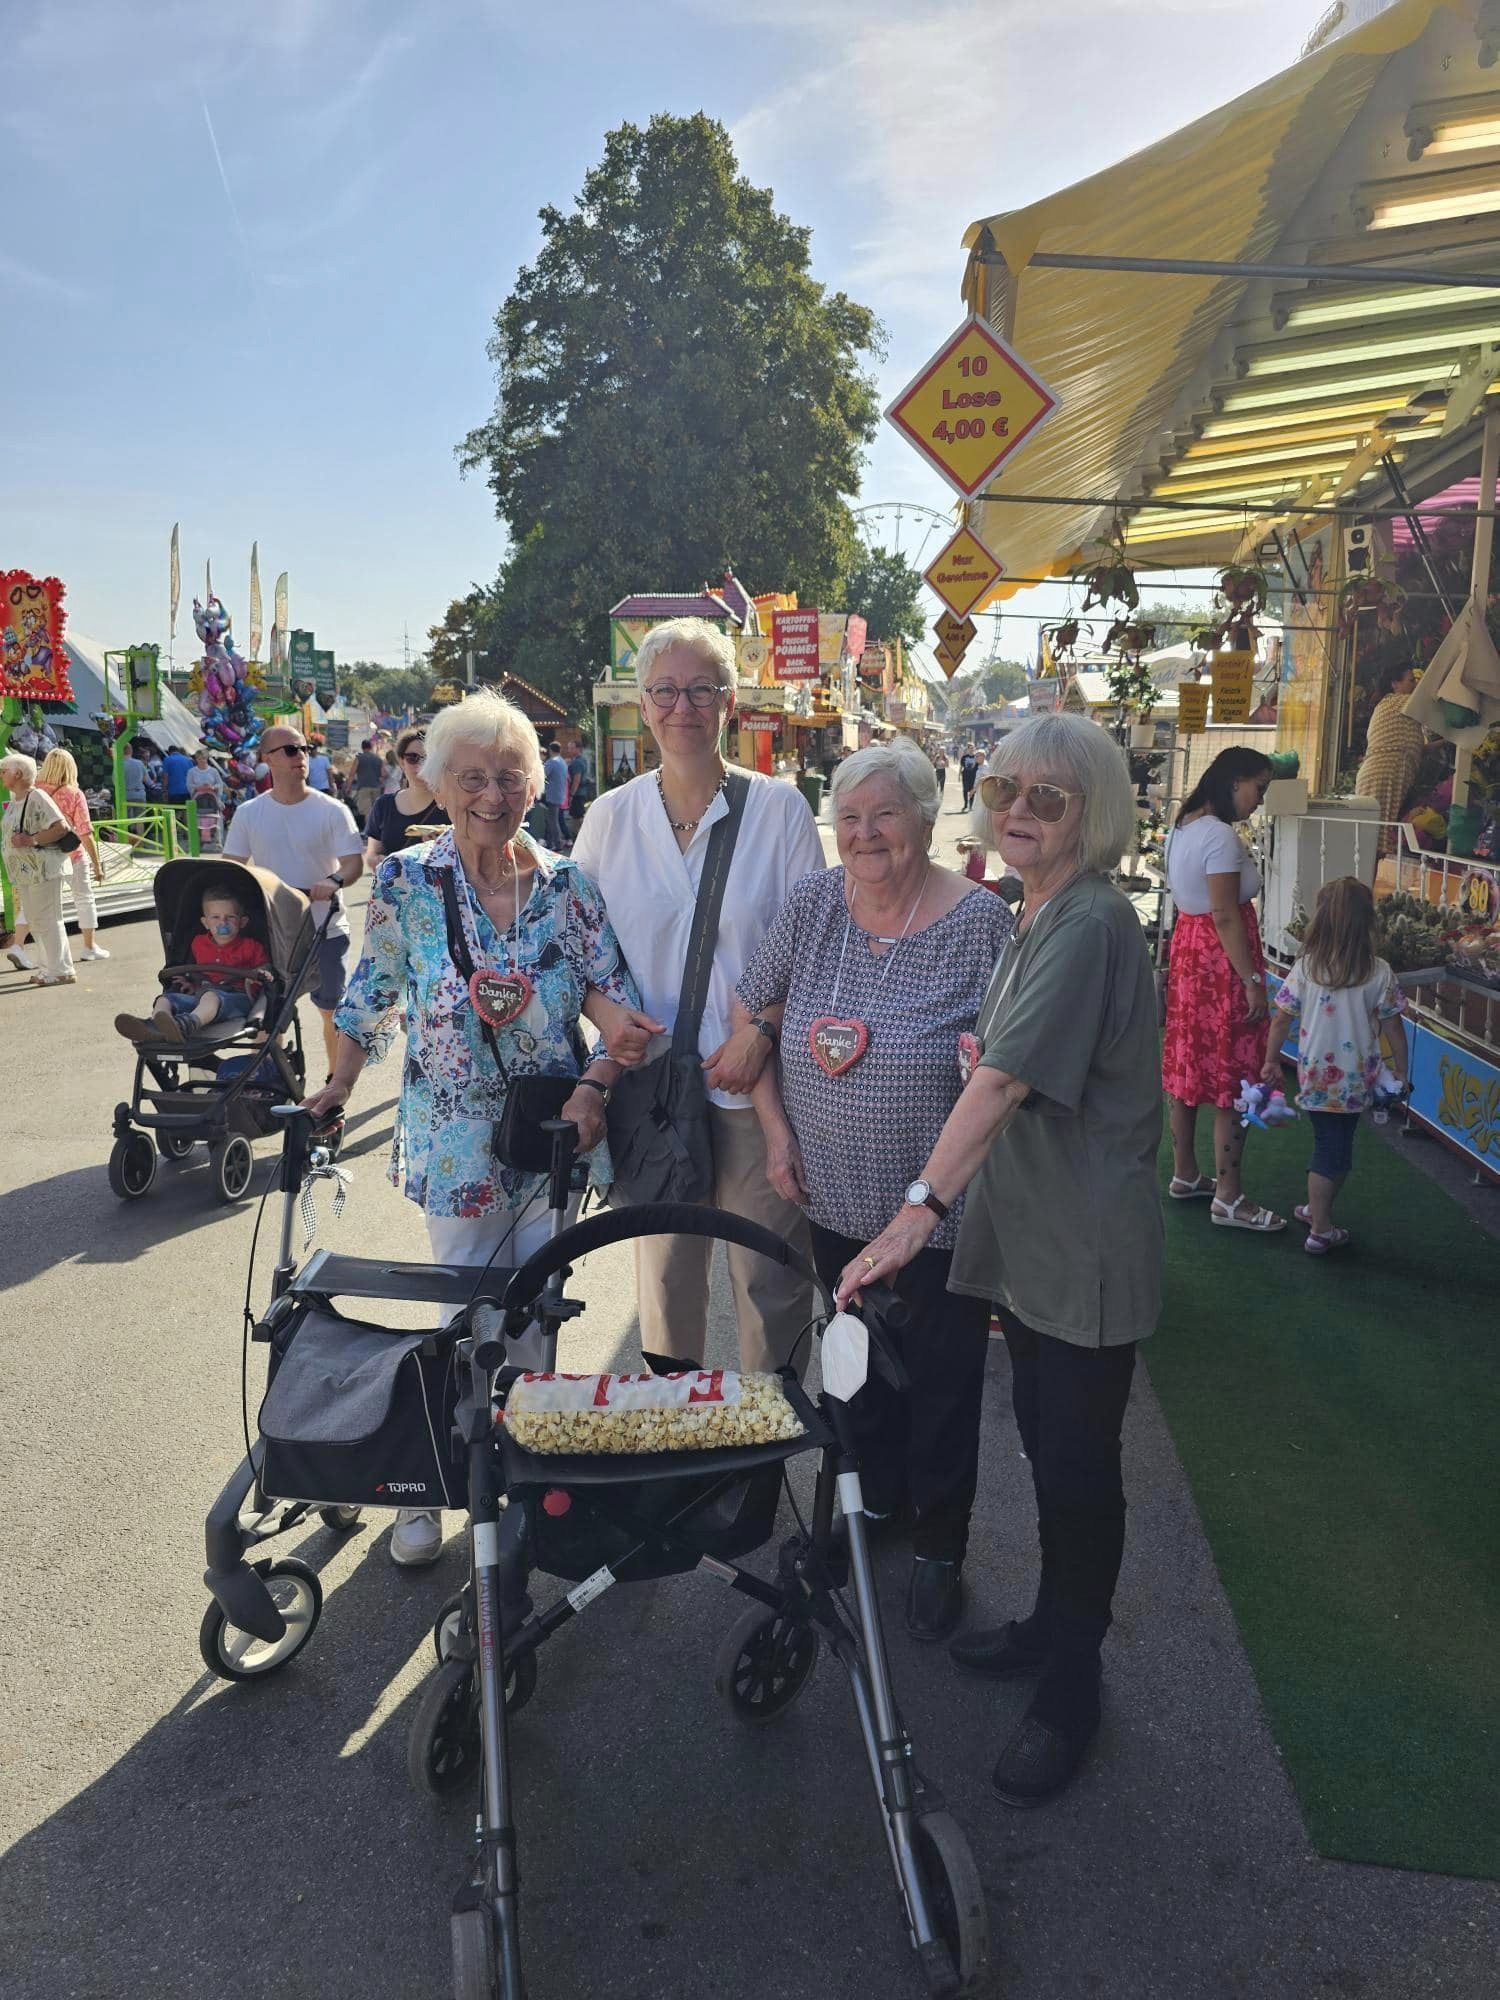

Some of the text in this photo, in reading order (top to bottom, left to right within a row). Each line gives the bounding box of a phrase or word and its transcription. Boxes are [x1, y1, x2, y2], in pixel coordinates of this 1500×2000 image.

[957, 355, 988, 378] 10
[942, 389, 1002, 410] Lose
[932, 416, 1009, 445] 4,00 €
[952, 554, 974, 567] Nur
[937, 571, 989, 584] Gewinne
[781, 624, 810, 634] PUFFER
[775, 644, 818, 656] POMMES
[778, 666, 816, 676] KARTOFFEL
[741, 721, 779, 731] POMMES
[478, 983, 523, 1001] Danke!
[816, 1031, 858, 1049] Danke!
[386, 1482, 427, 1493] TOPRO
